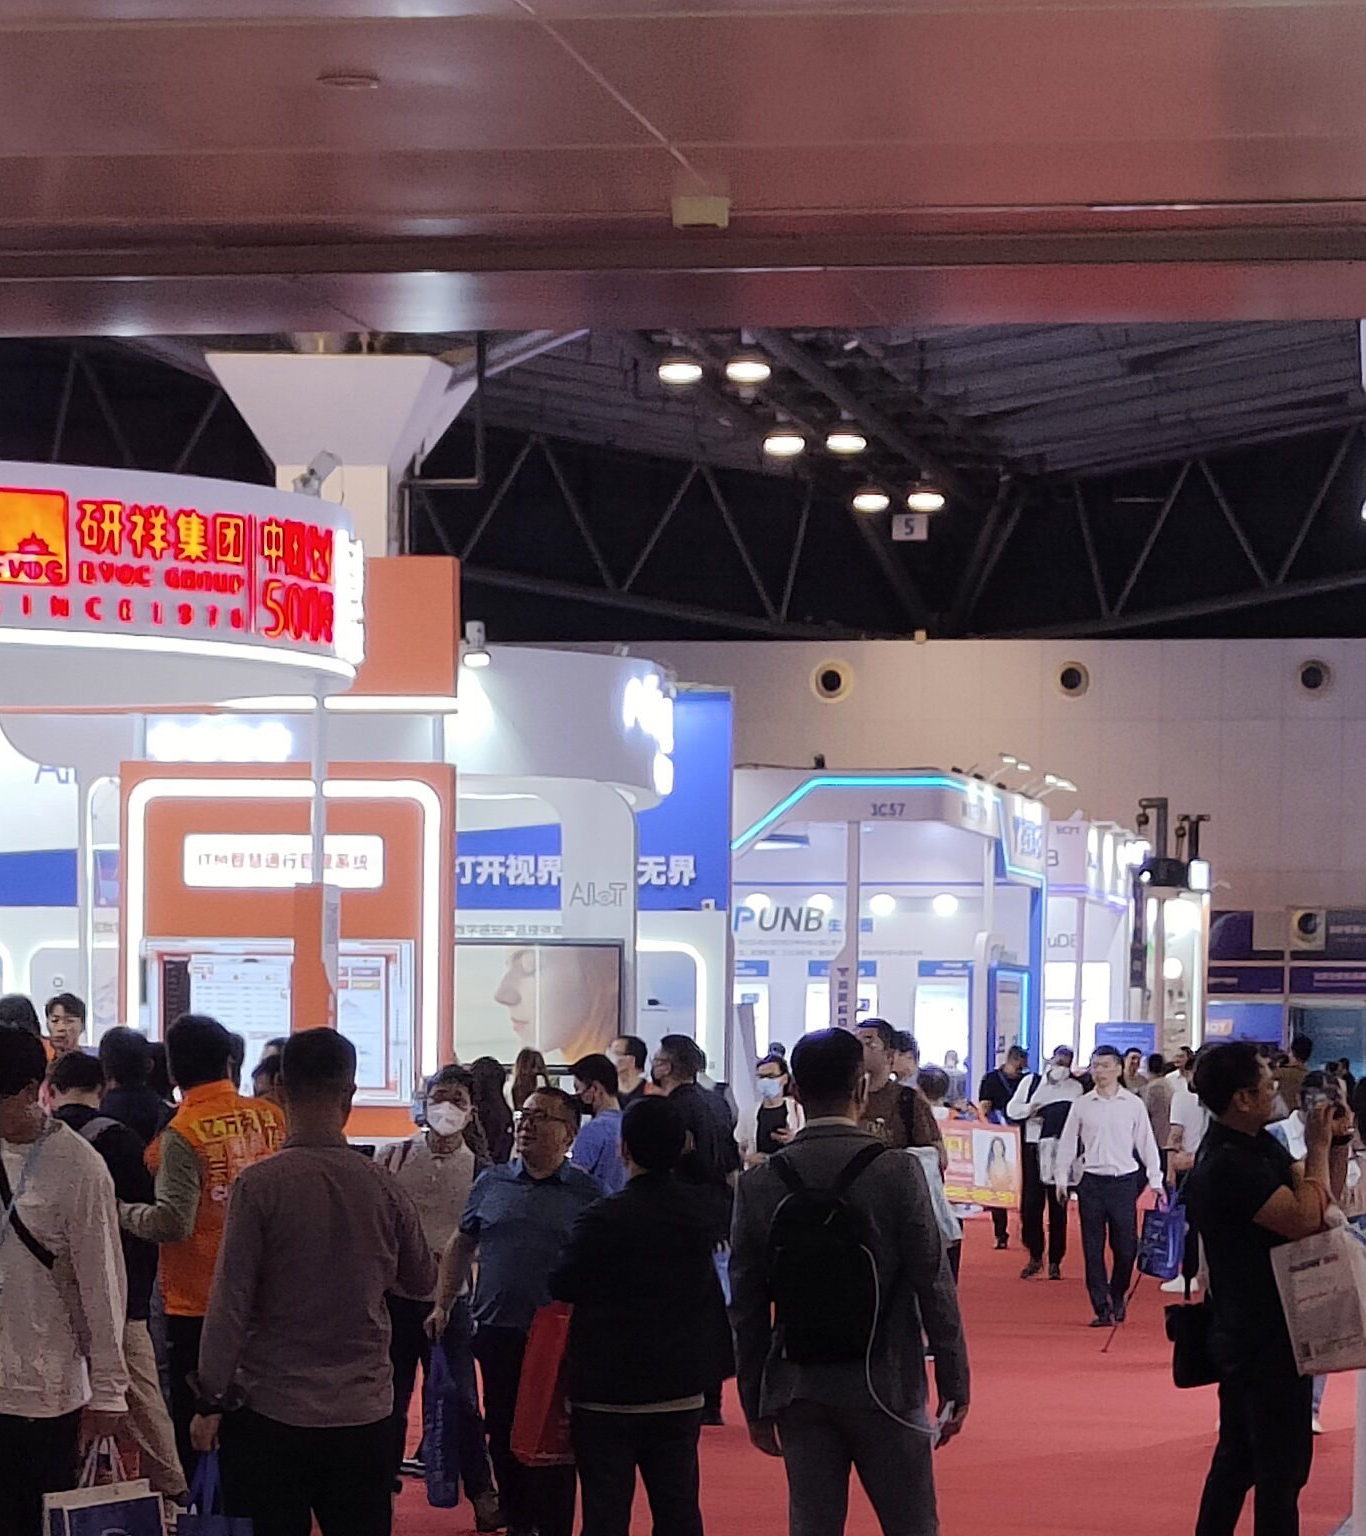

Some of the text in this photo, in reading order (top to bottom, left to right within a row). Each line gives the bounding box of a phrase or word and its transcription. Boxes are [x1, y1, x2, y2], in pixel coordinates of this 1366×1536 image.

[77, 500, 245, 566] 研祥集团
[637, 855, 696, 886] 无界
[569, 881, 627, 907] AIoT
